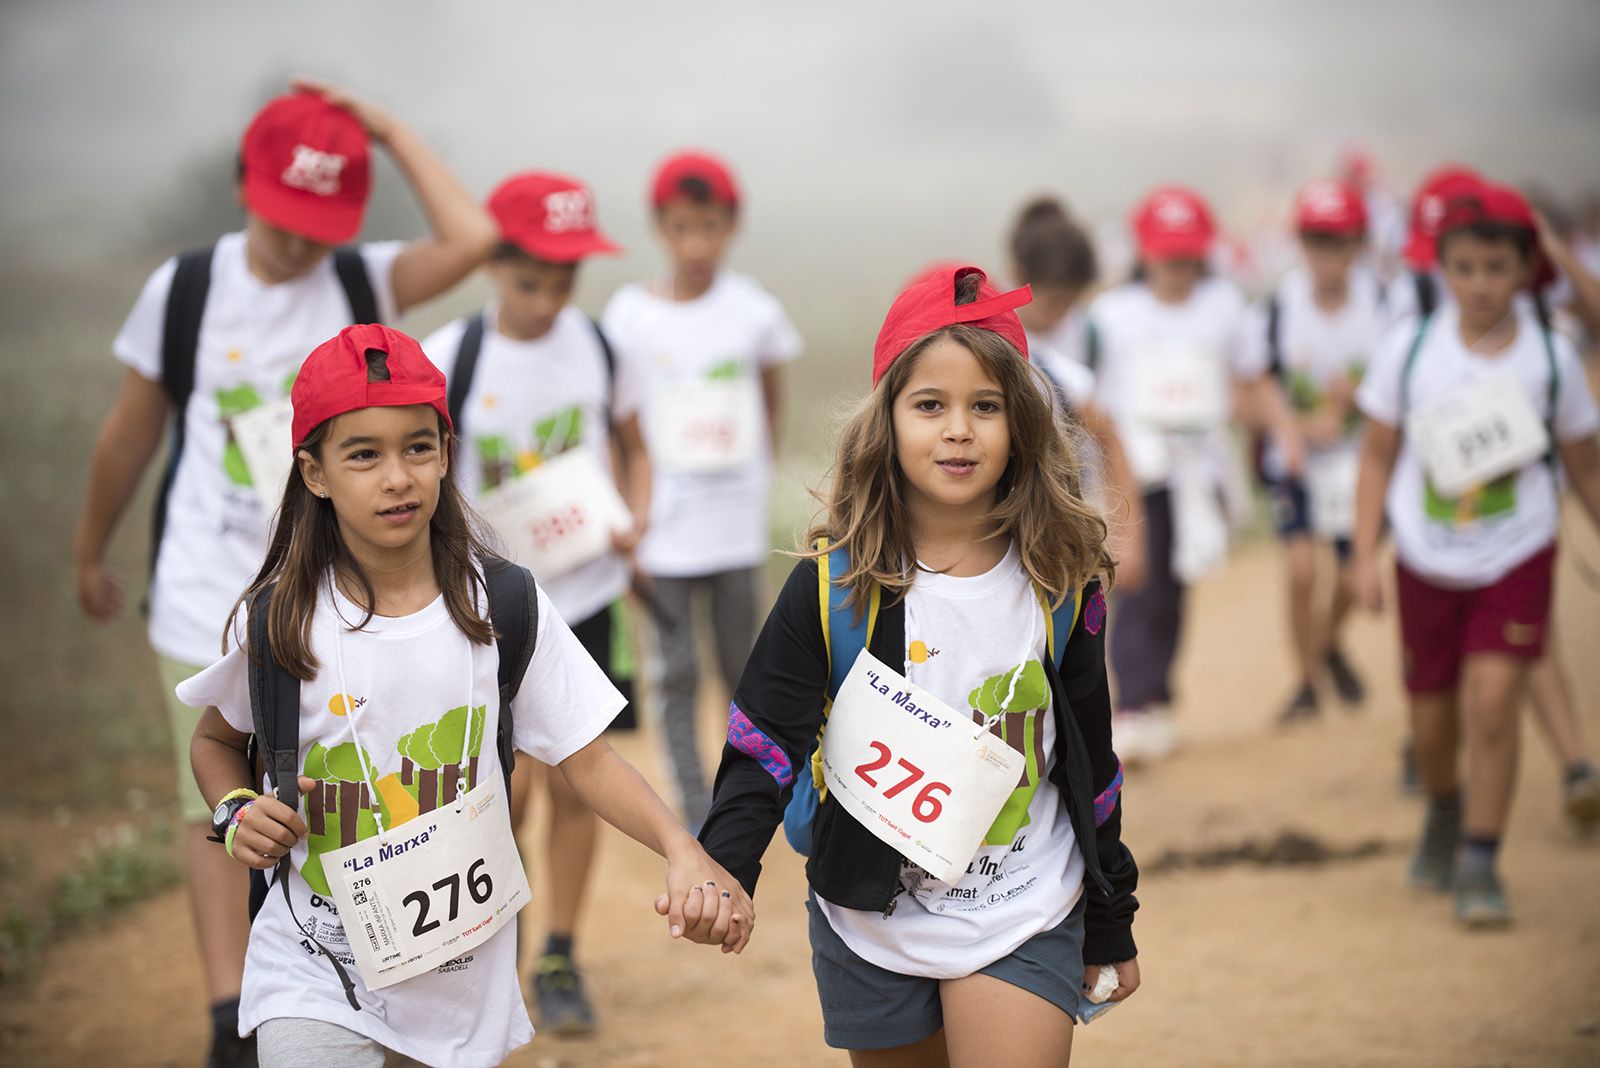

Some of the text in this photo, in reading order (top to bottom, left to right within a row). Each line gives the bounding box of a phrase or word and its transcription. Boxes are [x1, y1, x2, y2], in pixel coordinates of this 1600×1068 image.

[891, 690, 952, 729] Marxa”
[854, 740, 952, 823] 276
[379, 824, 437, 863] Marxa”
[352, 877, 371, 890] 276
[402, 857, 493, 937] 276
